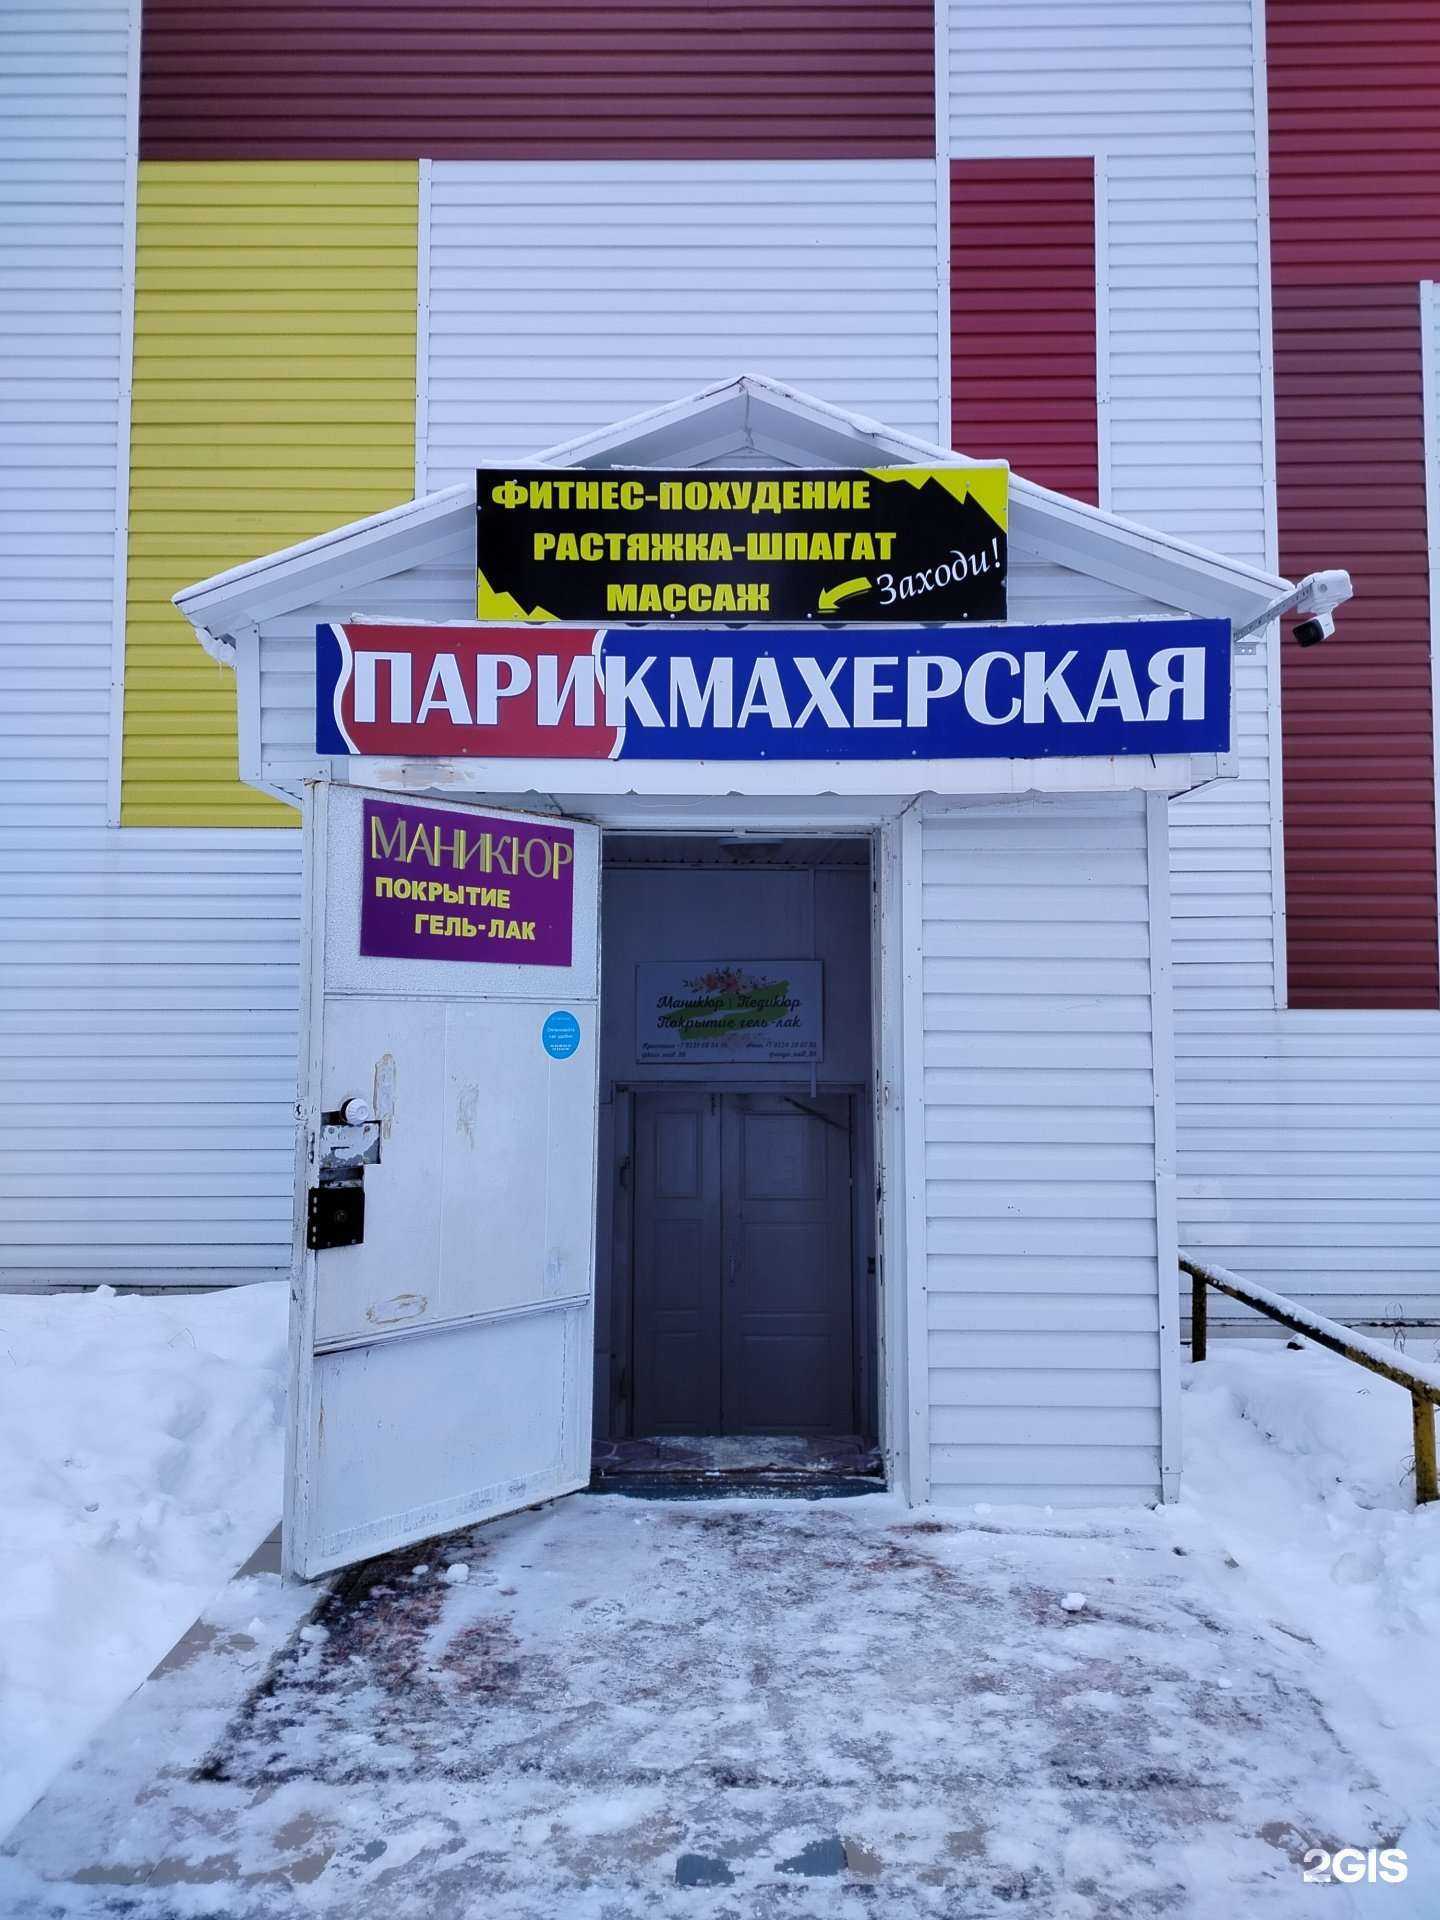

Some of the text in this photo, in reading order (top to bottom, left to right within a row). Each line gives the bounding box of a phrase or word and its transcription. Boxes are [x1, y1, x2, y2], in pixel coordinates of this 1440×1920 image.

[491, 480, 871, 514] ФИТНЕС-ПОХУДЕНИЕ
[533, 531, 897, 561] РАСТЯЖКА-ШПАГАТ
[875, 537, 1002, 606] Заходи!
[606, 583, 770, 613] МАССАЖ
[353, 646, 1207, 729] ПАРИКМАХЕРСКАЯ
[371, 815, 574, 880] МАНИКЮР
[375, 876, 511, 909] ПОКРЫТИЕ
[414, 913, 536, 941] ГЕЛЬ-ЛАК
